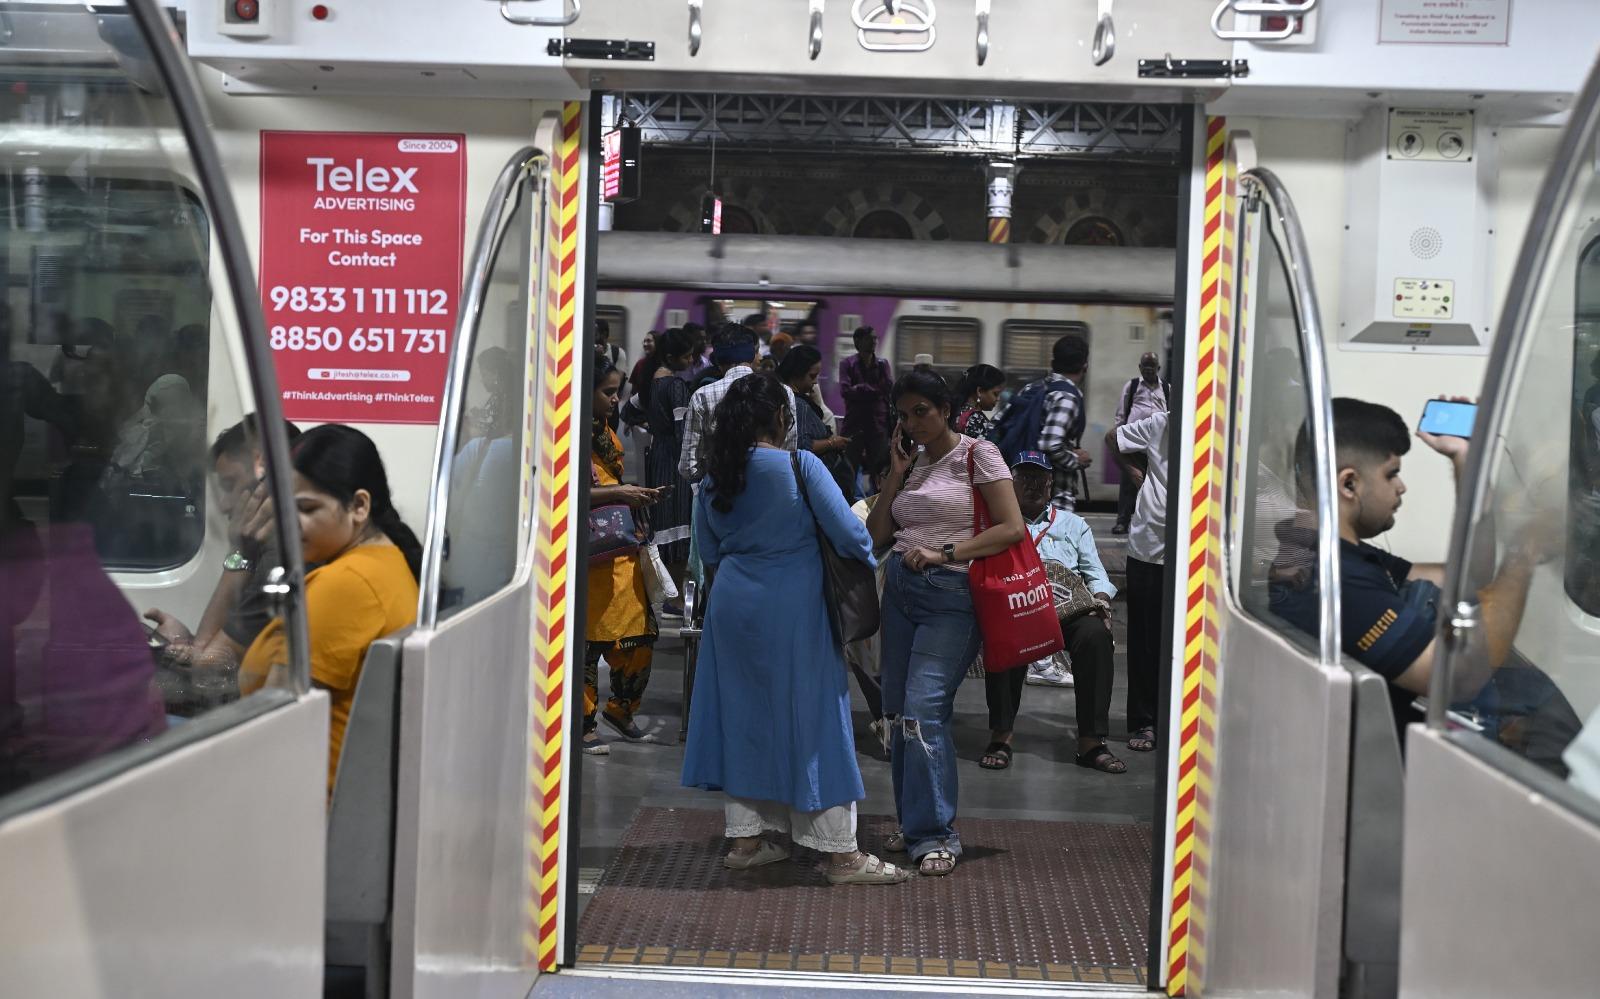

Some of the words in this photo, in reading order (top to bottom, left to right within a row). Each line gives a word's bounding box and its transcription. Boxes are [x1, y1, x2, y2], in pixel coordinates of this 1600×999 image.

[403, 140, 427, 150] Since
[428, 141, 452, 151] 2004
[306, 157, 419, 193] Telex
[313, 197, 415, 212] ADVERTISING
[299, 228, 329, 244] For
[332, 228, 368, 245] This
[371, 229, 423, 248] Space
[327, 250, 397, 267] Contact
[270, 285, 346, 313] 9833
[403, 288, 449, 315] 112
[269, 325, 343, 351] 8850
[348, 327, 395, 353] 651
[401, 328, 447, 354] 731
[282, 390, 373, 404] #ThinkAdvertising
[374, 393, 435, 404] #ThinkTelex
